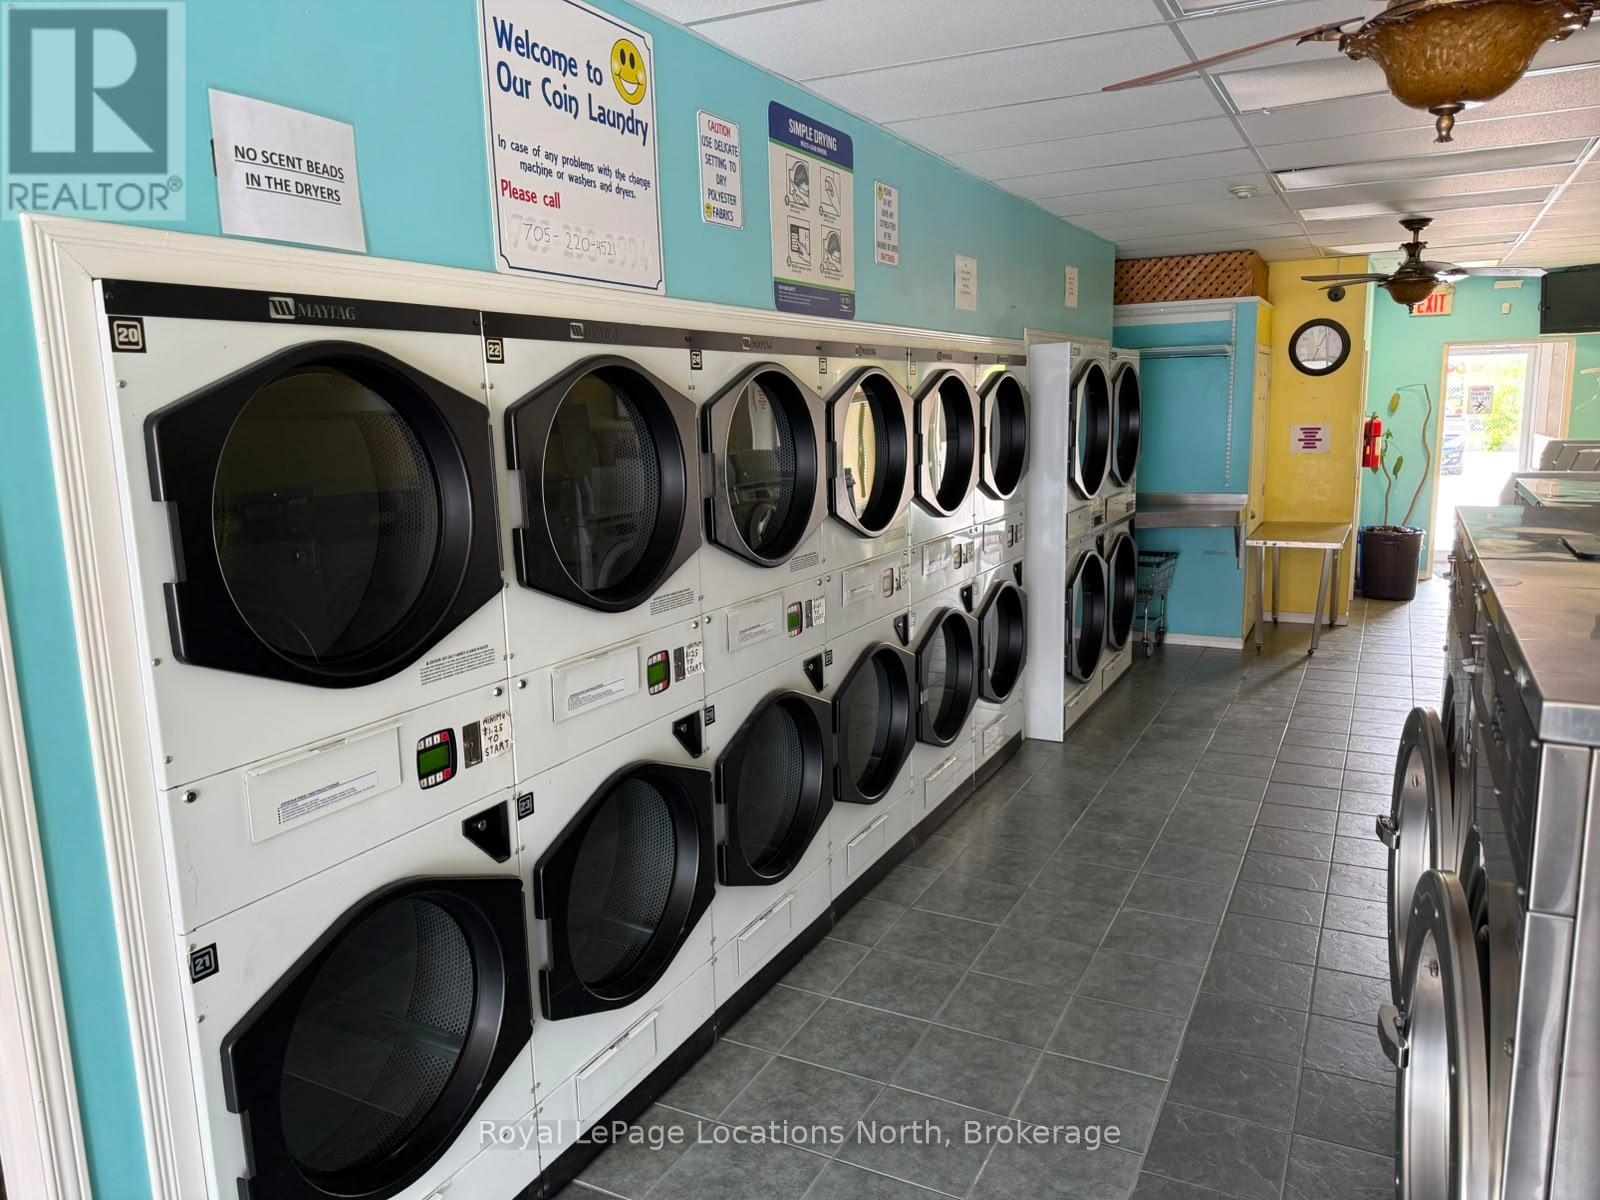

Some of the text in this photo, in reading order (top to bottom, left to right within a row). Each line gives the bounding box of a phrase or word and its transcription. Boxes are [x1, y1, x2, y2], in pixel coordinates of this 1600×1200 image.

[493, 16, 603, 87] Welcome to
[497, 61, 649, 146] Our Coin Laundry
[707, 120, 731, 137] CAUTION
[788, 118, 813, 141] SIMPLE
[813, 129, 837, 152] DRYING
[701, 135, 738, 157] USE DELICATE
[234, 145, 344, 180] NO SCENT BEADS
[497, 134, 651, 190] In case of any problems with the change
[705, 153, 737, 173] SETTING TO
[245, 172, 341, 202] IN THE DRYERS
[520, 160, 637, 199] machine or washers and dryers.
[715, 174, 727, 187] DRY
[501, 179, 561, 209] Please call
[707, 188, 737, 206] POLYESTER
[712, 206, 734, 222] FABRICS
[297, 302, 357, 320] MAYTAG
[117, 327, 138, 343] 20
[483, 723, 503, 736] $1.25
[488, 733, 499, 743] TO
[485, 739, 509, 757] START
[195, 954, 210, 972] 21
